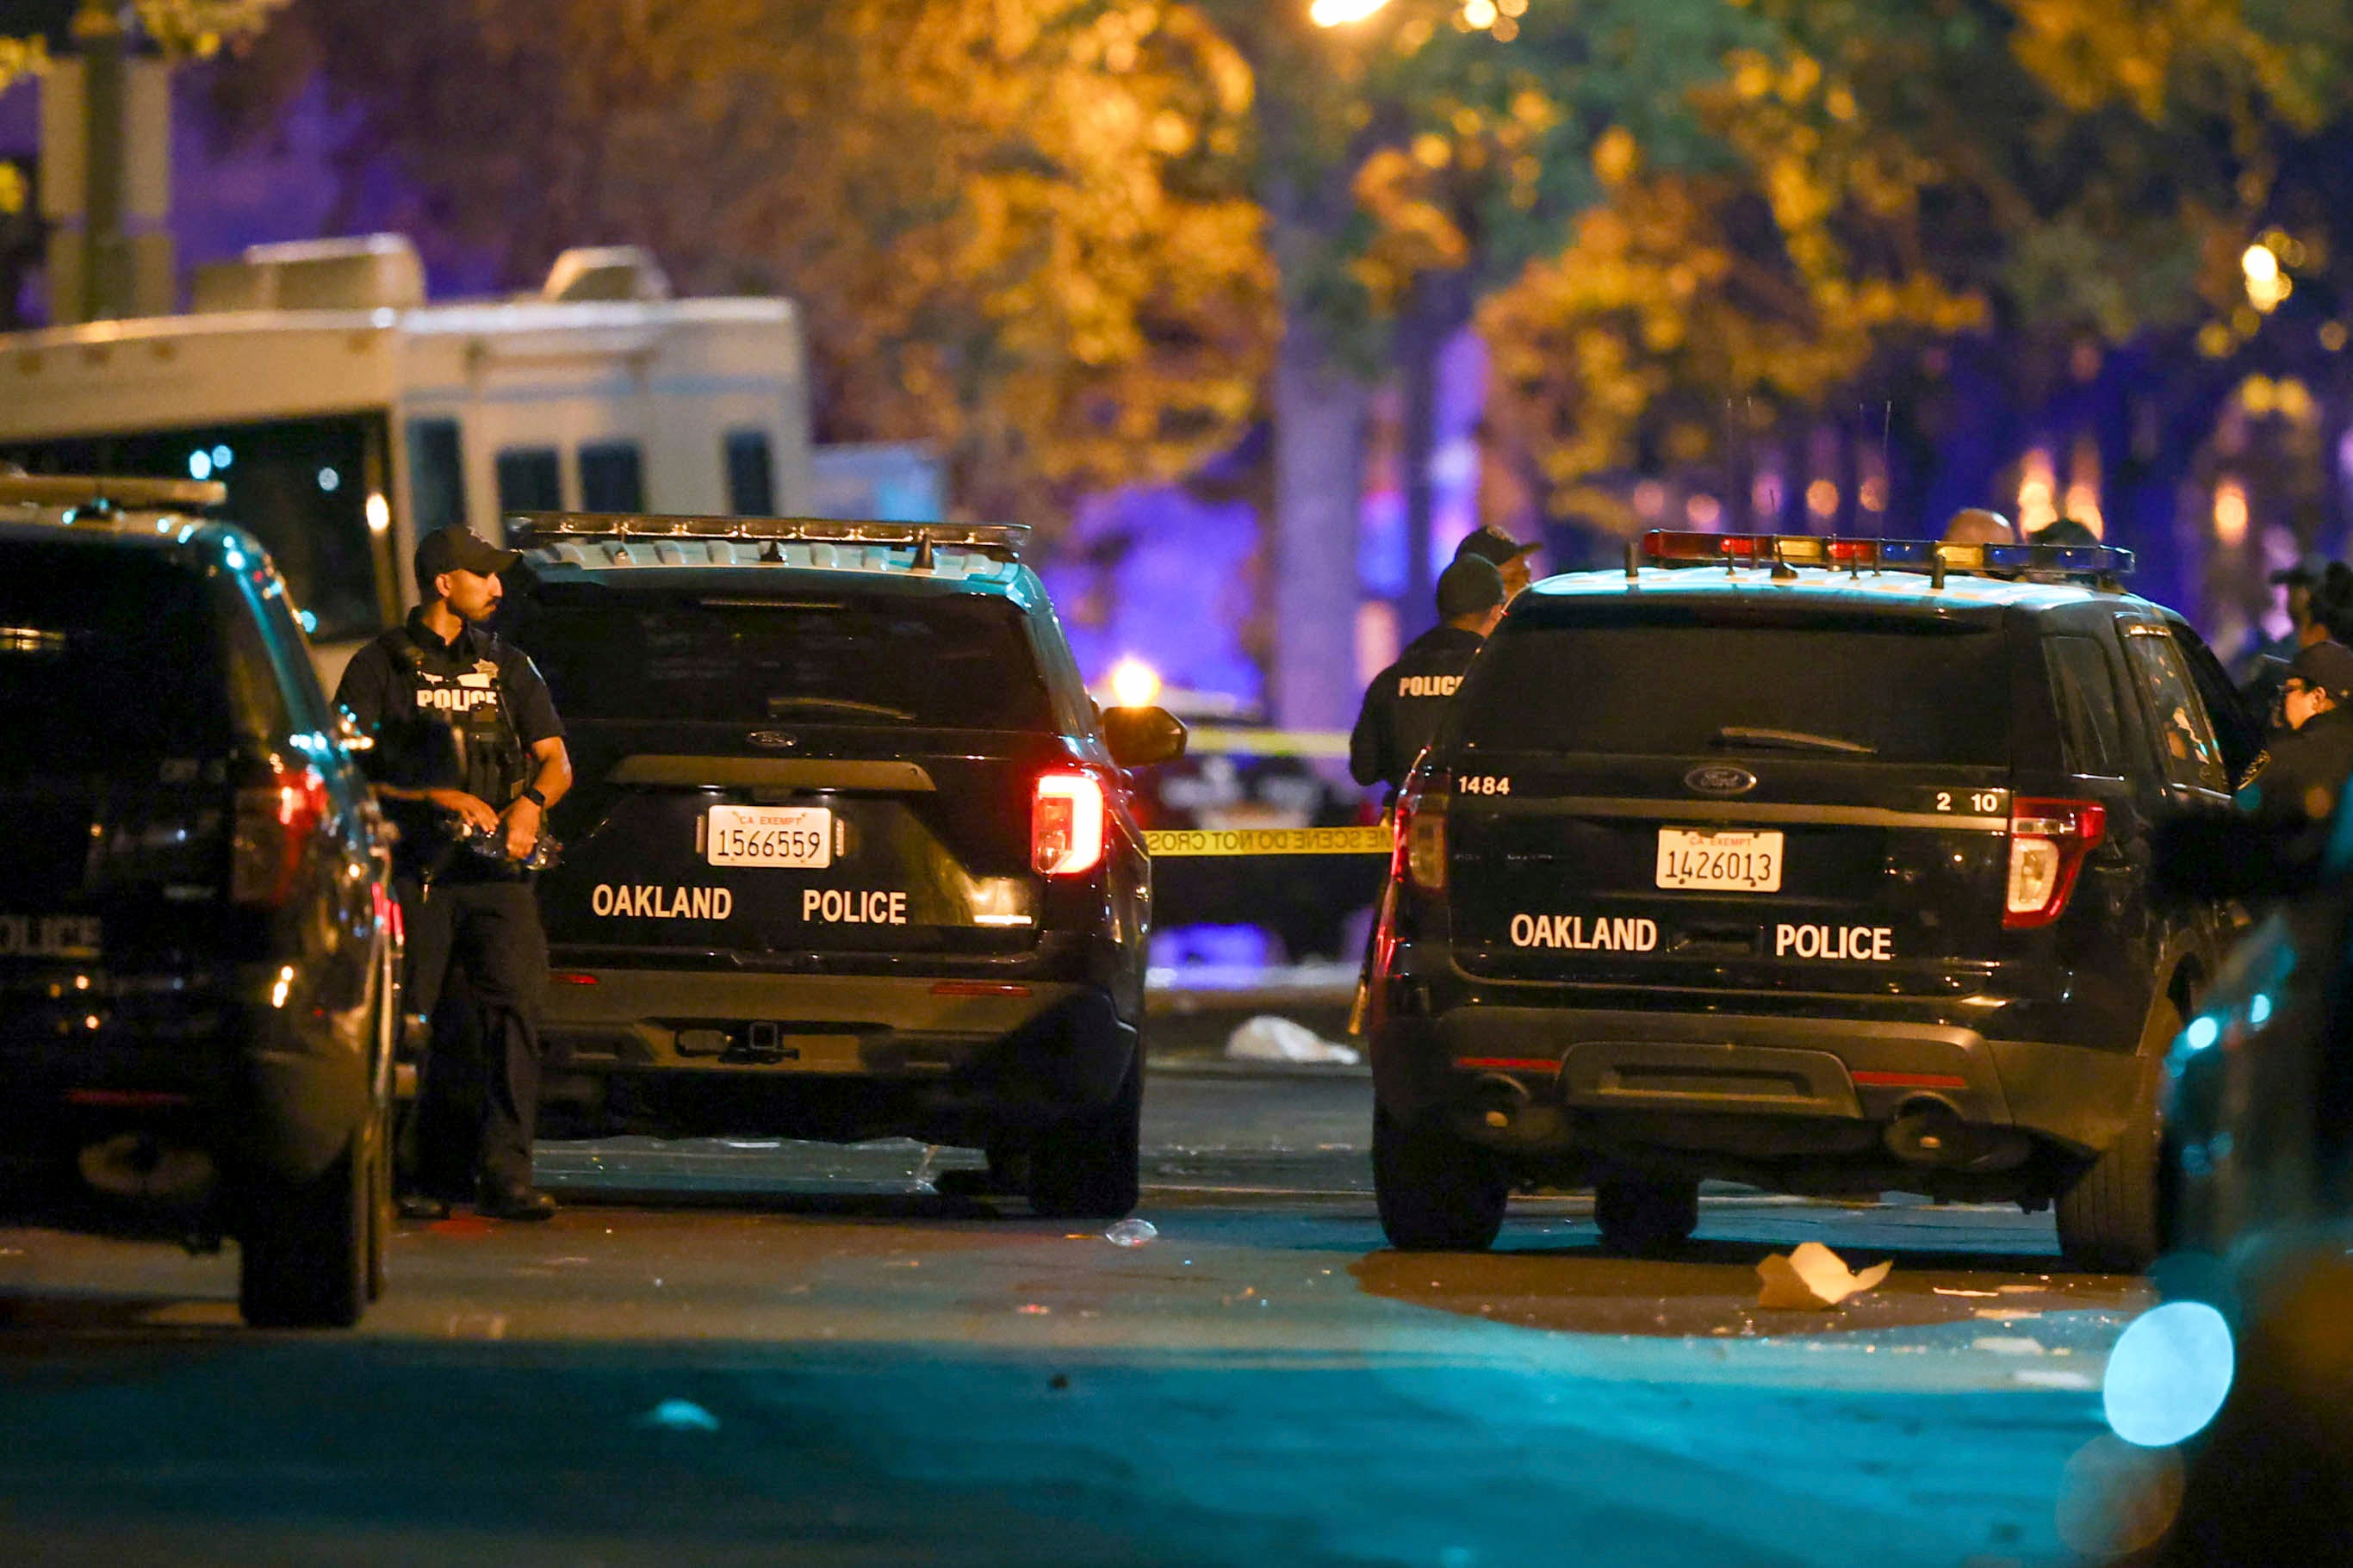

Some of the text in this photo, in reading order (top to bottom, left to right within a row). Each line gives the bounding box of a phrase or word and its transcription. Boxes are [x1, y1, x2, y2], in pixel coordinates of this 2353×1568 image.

[1458, 775, 1511, 796] 1484
[1936, 791, 1998, 813] 2 10
[738, 815, 803, 826] CA EXEMPT
[717, 829, 821, 859] 1566559
[1688, 836, 1752, 847] CA EXEMPT
[1665, 851, 1773, 882] 1426013
[592, 883, 908, 924] OAKLAND POLICE
[1510, 913, 1893, 961] OAKLAND POLICE
